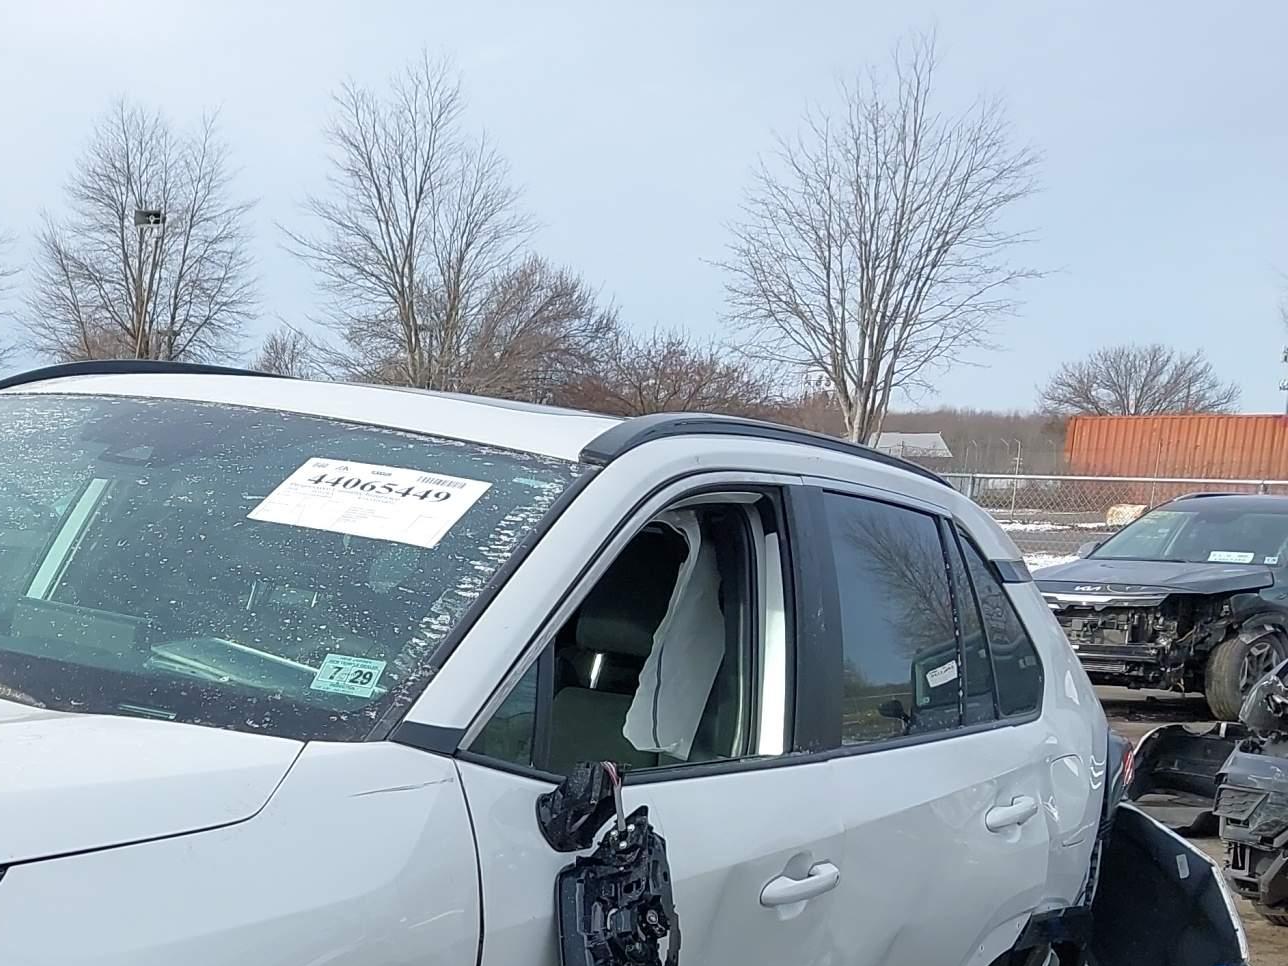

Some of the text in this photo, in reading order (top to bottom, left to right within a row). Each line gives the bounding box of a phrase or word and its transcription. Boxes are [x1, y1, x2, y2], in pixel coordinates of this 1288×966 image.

[308, 473, 452, 503] 44065449
[328, 666, 344, 680] 7
[348, 669, 374, 686] 29
